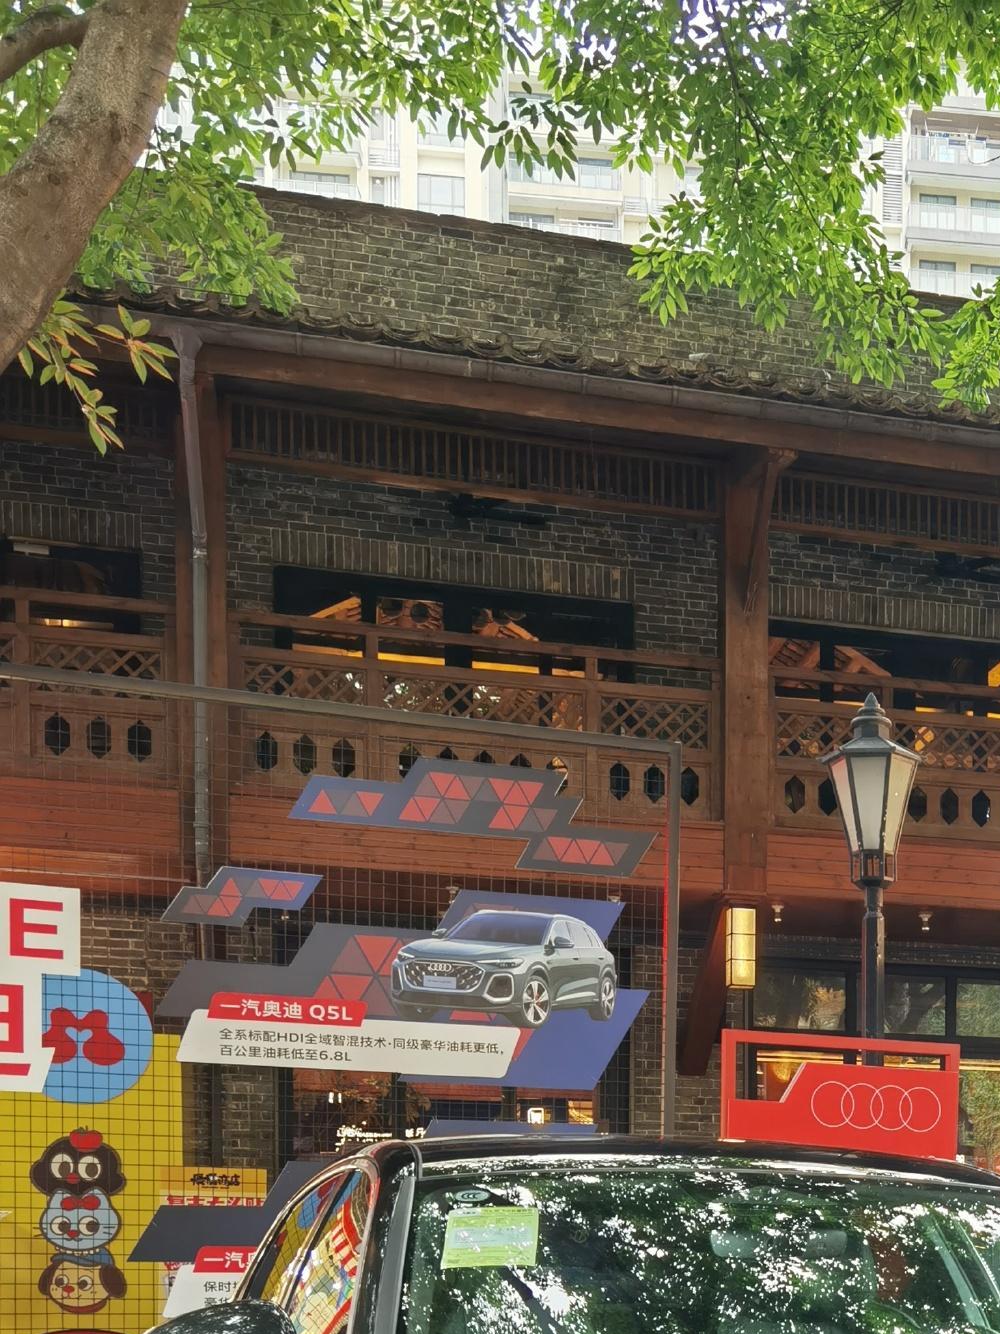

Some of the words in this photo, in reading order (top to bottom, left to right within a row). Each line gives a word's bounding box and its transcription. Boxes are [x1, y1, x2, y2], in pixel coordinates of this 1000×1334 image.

[219, 998, 304, 1020] 一汽奥迪
[309, 1004, 354, 1022] Q5L
[219, 1044, 353, 1063] 百公里油耗低至6.8L
[203, 1280, 237, 1293] 保时
